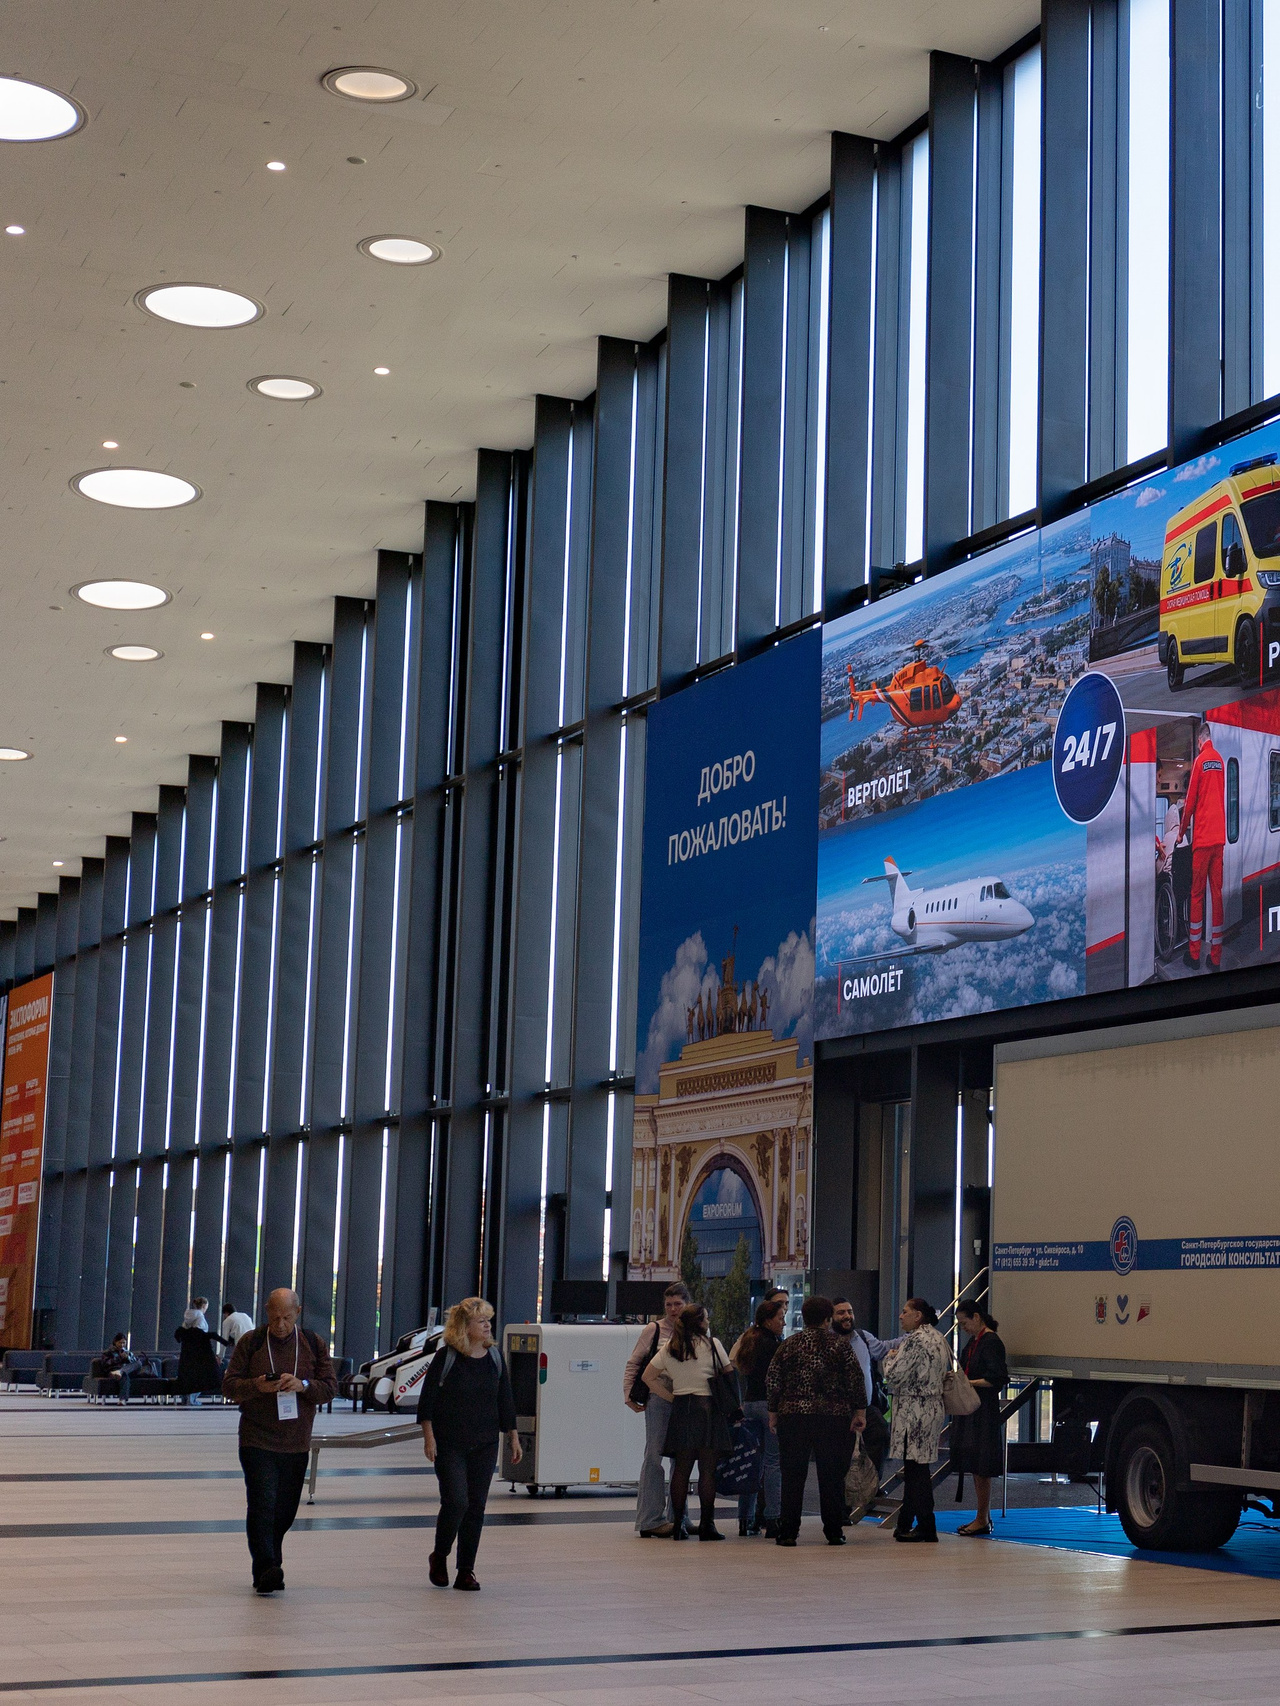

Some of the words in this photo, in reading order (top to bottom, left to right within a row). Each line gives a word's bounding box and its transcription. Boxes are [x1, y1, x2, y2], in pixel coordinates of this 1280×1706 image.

[1062, 722, 1116, 772] 24/7
[697, 750, 755, 806] ДОБРО
[848, 768, 910, 808] ВЕРТОЛЁТ
[668, 796, 787, 866] ПОЖАЛОВАТЬ!
[843, 965, 904, 1000] САМОЛЁТ
[702, 1202, 742, 1218] EXPOFORUM
[1078, 1245, 1084, 1254] 10
[1180, 1250, 1226, 1268] ГОРОДСКОЙ
[406, 1362, 430, 1386] YAMAGUCHI
